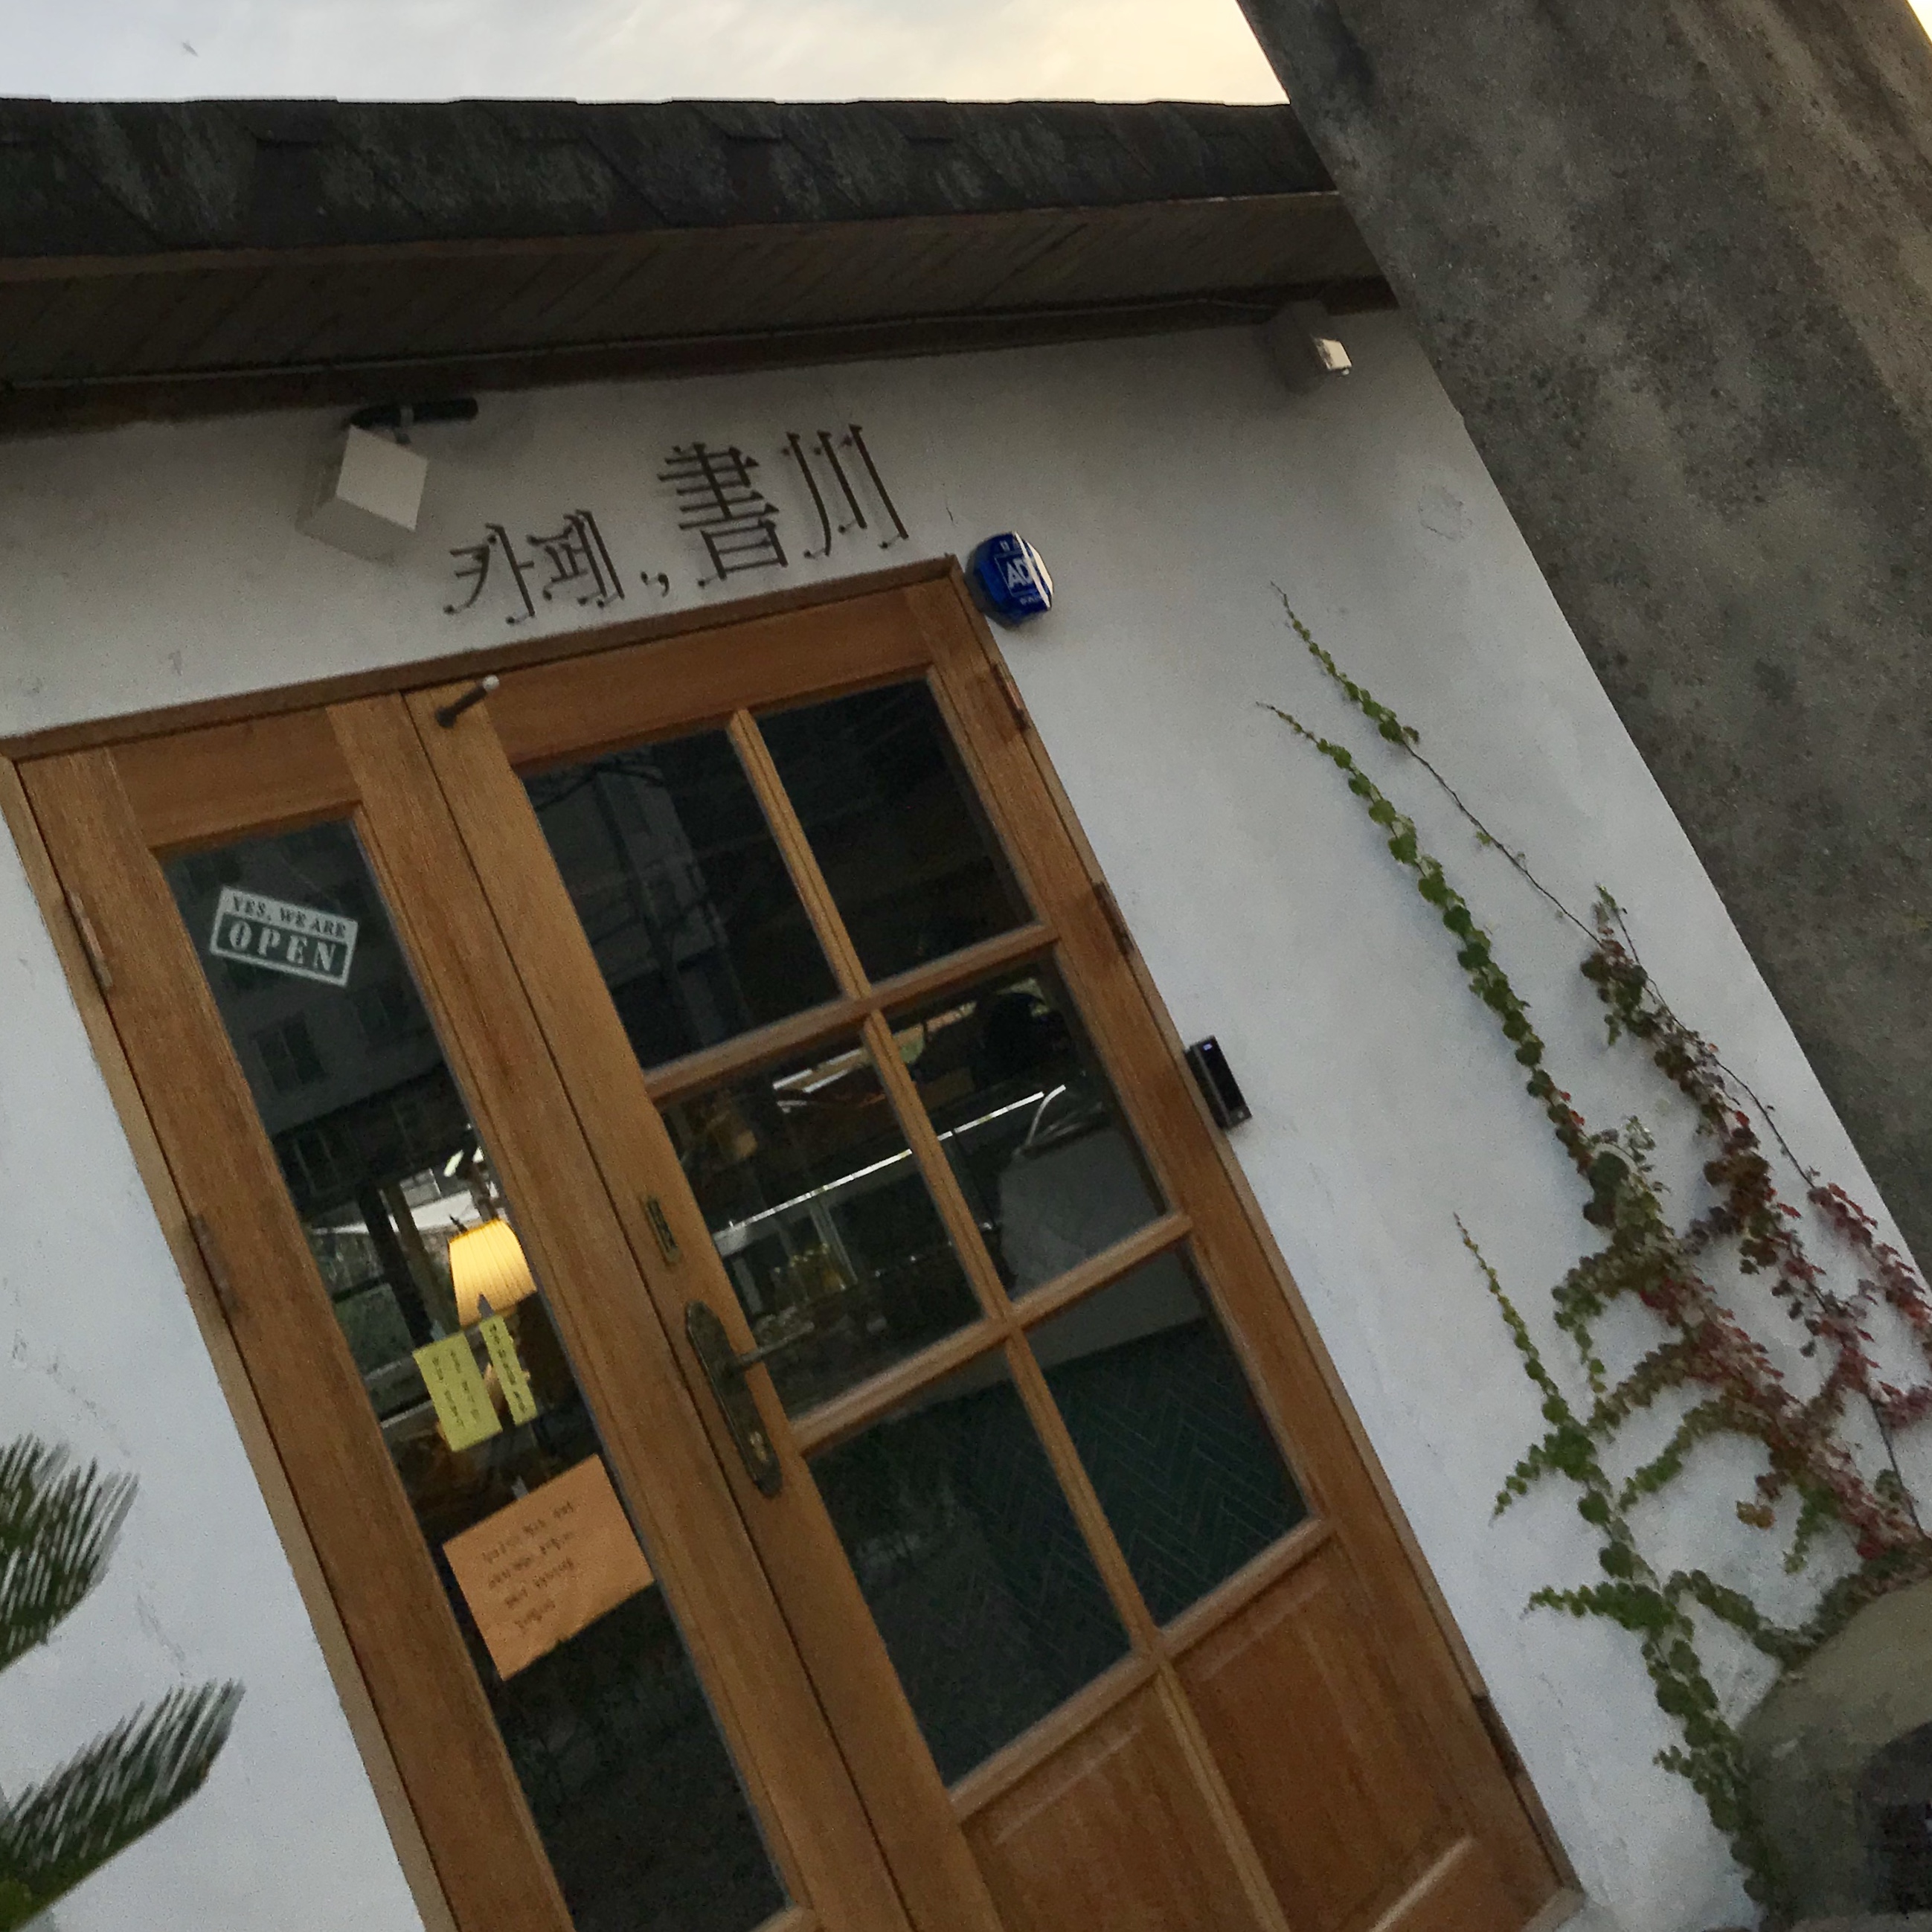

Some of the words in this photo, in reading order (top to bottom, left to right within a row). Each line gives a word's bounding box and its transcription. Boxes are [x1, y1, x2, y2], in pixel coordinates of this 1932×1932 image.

[280, 906, 307, 928] WE
[309, 917, 346, 938] ARE
[228, 920, 336, 972] OPEN
